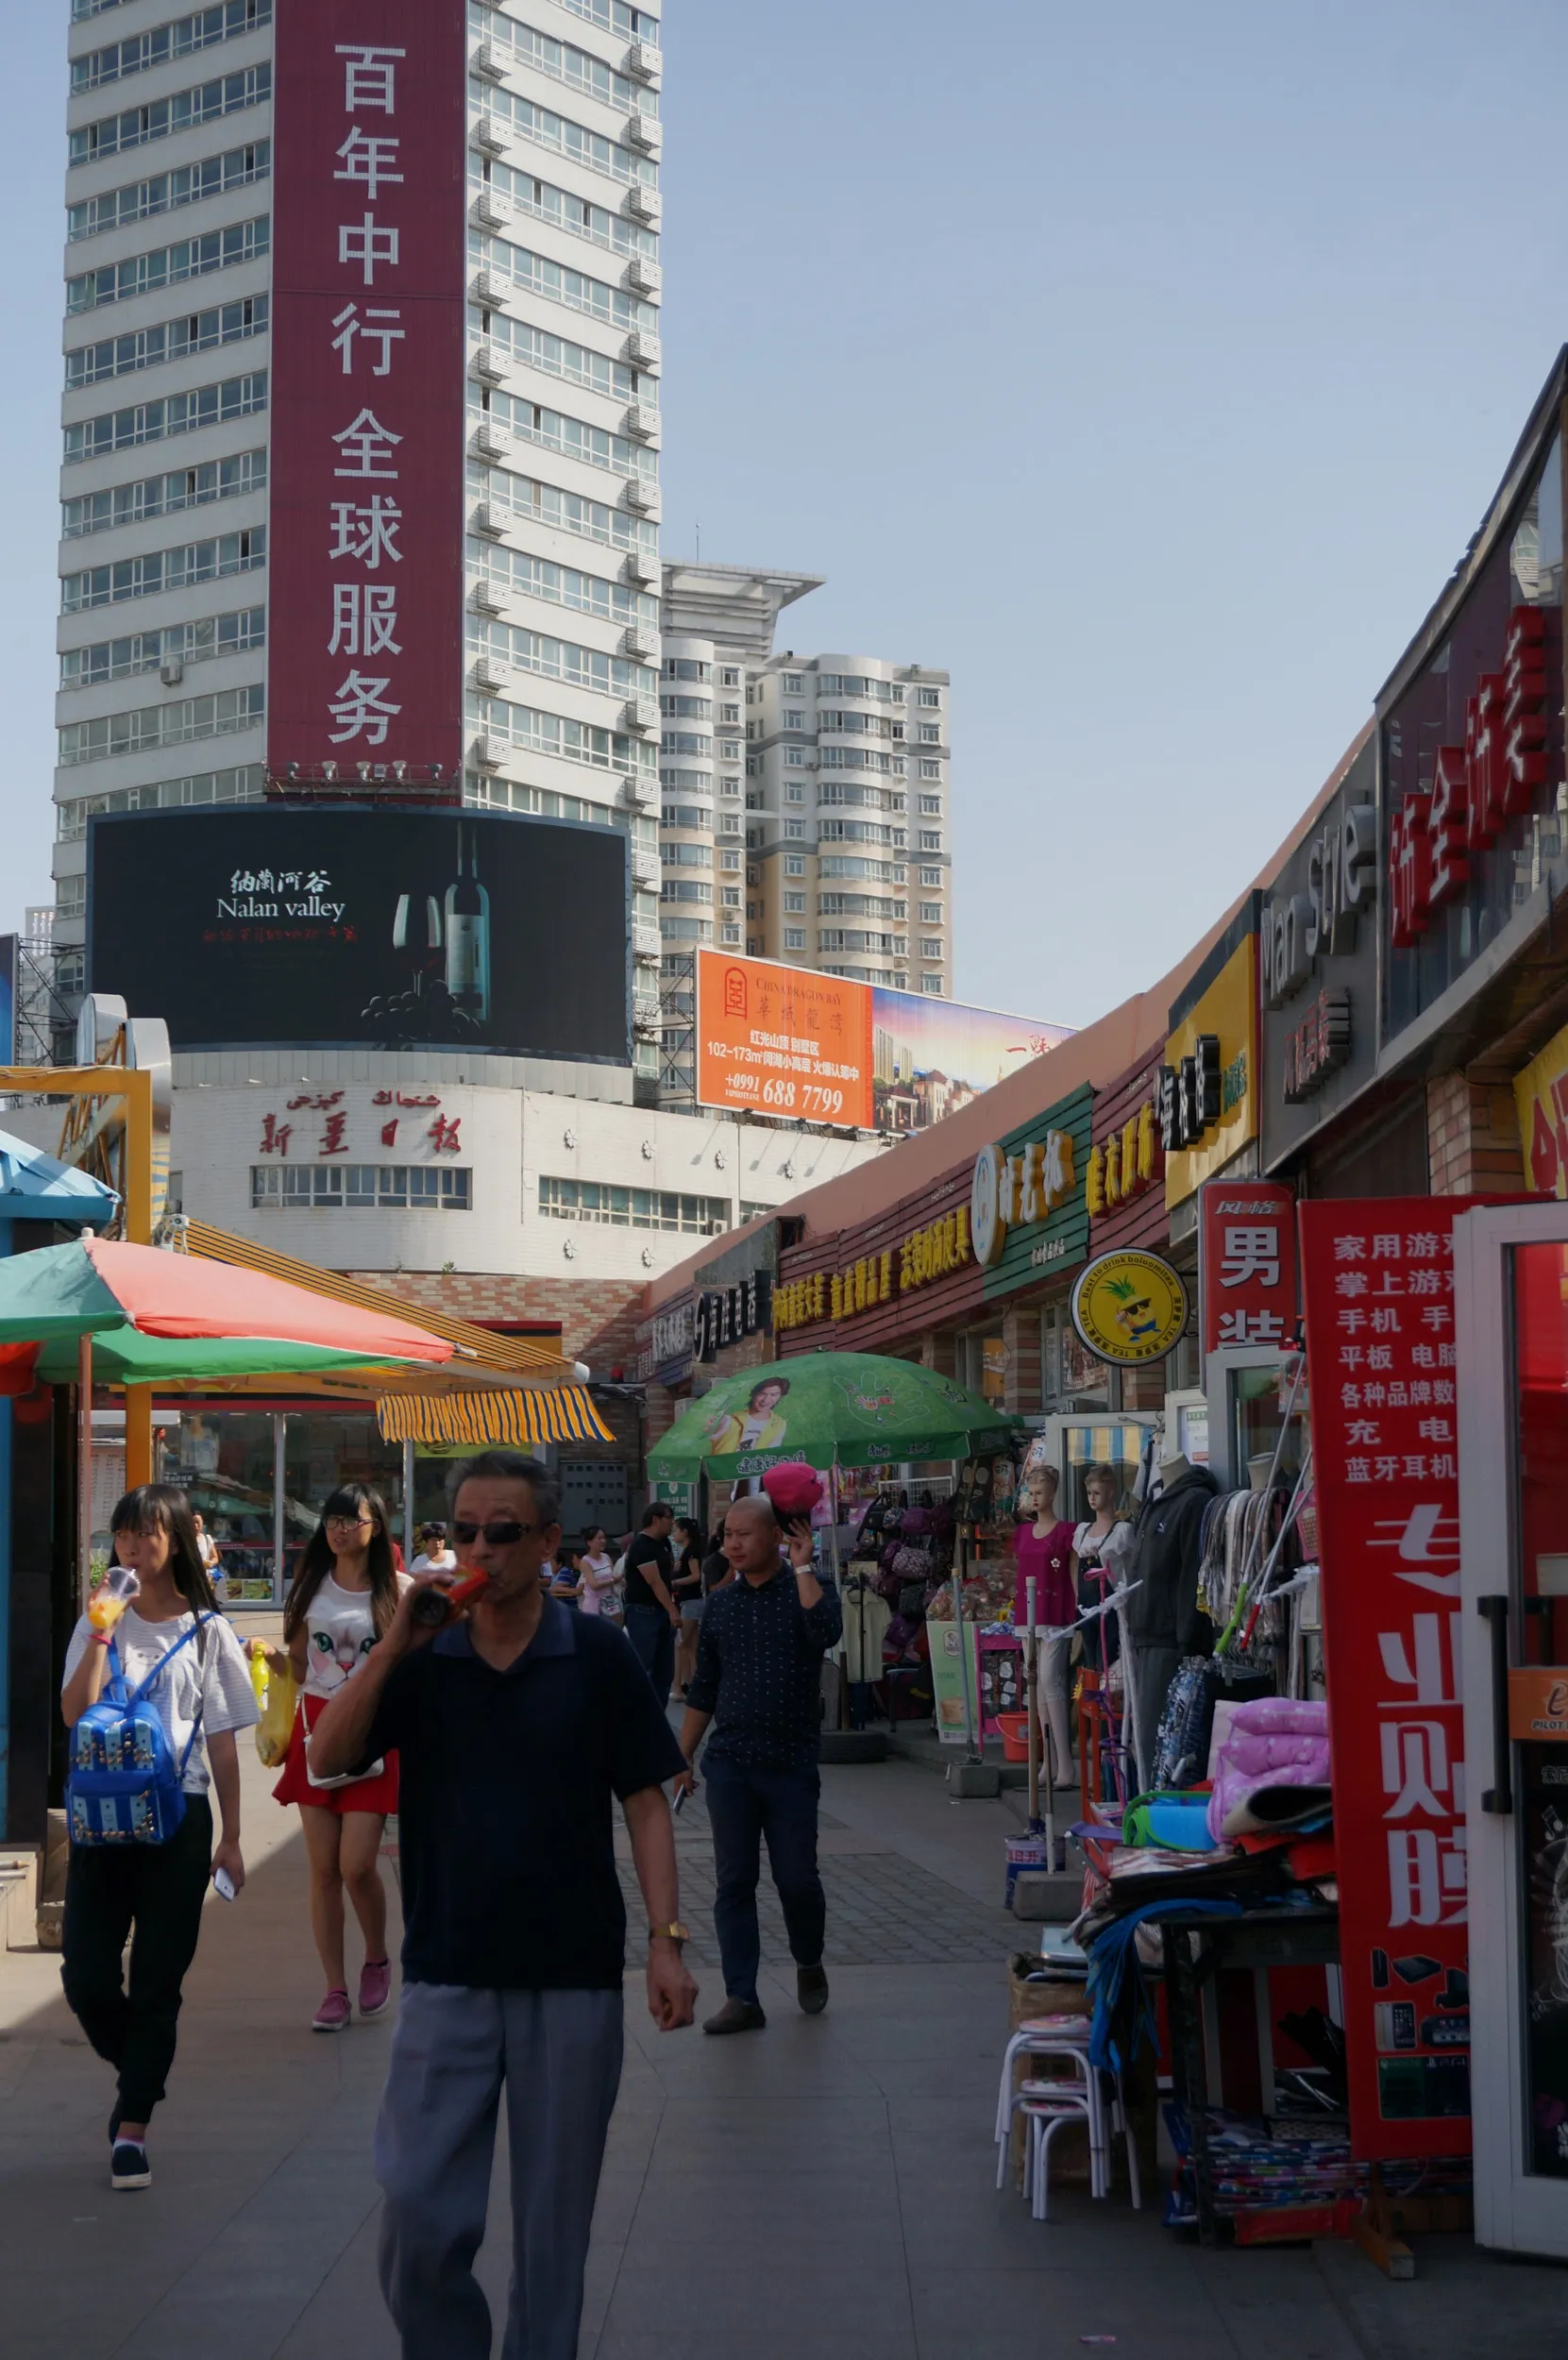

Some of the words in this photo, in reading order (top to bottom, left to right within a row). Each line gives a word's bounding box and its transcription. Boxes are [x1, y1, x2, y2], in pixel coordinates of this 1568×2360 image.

[327, 44, 406, 746] 百年中行全球服务
[1306, 804, 1376, 955] Style
[216, 896, 279, 919] Nalan
[284, 895, 346, 923] valley
[826, 991, 843, 1006] BAY
[725, 1072, 760, 1093] +0991
[763, 1078, 796, 1107] 688
[801, 1084, 844, 1114] 7799
[1215, 1200, 1276, 1216] 风格
[1082, 1278, 1095, 1299] Best
[1103, 1256, 1126, 1271] drink
[1218, 1226, 1285, 1350] 男装
[1081, 1308, 1090, 1327] TEA
[1337, 1306, 1402, 1336] 手机
[1421, 1306, 1452, 1332] 手
[1339, 1343, 1393, 1372] 平板
[1411, 1342, 1457, 1370] 电脑
[1340, 1378, 1455, 1409] 各种品牌数
[1345, 1454, 1457, 1483] 蓝牙耳机
[1532, 1719, 1564, 1730] PILOT
